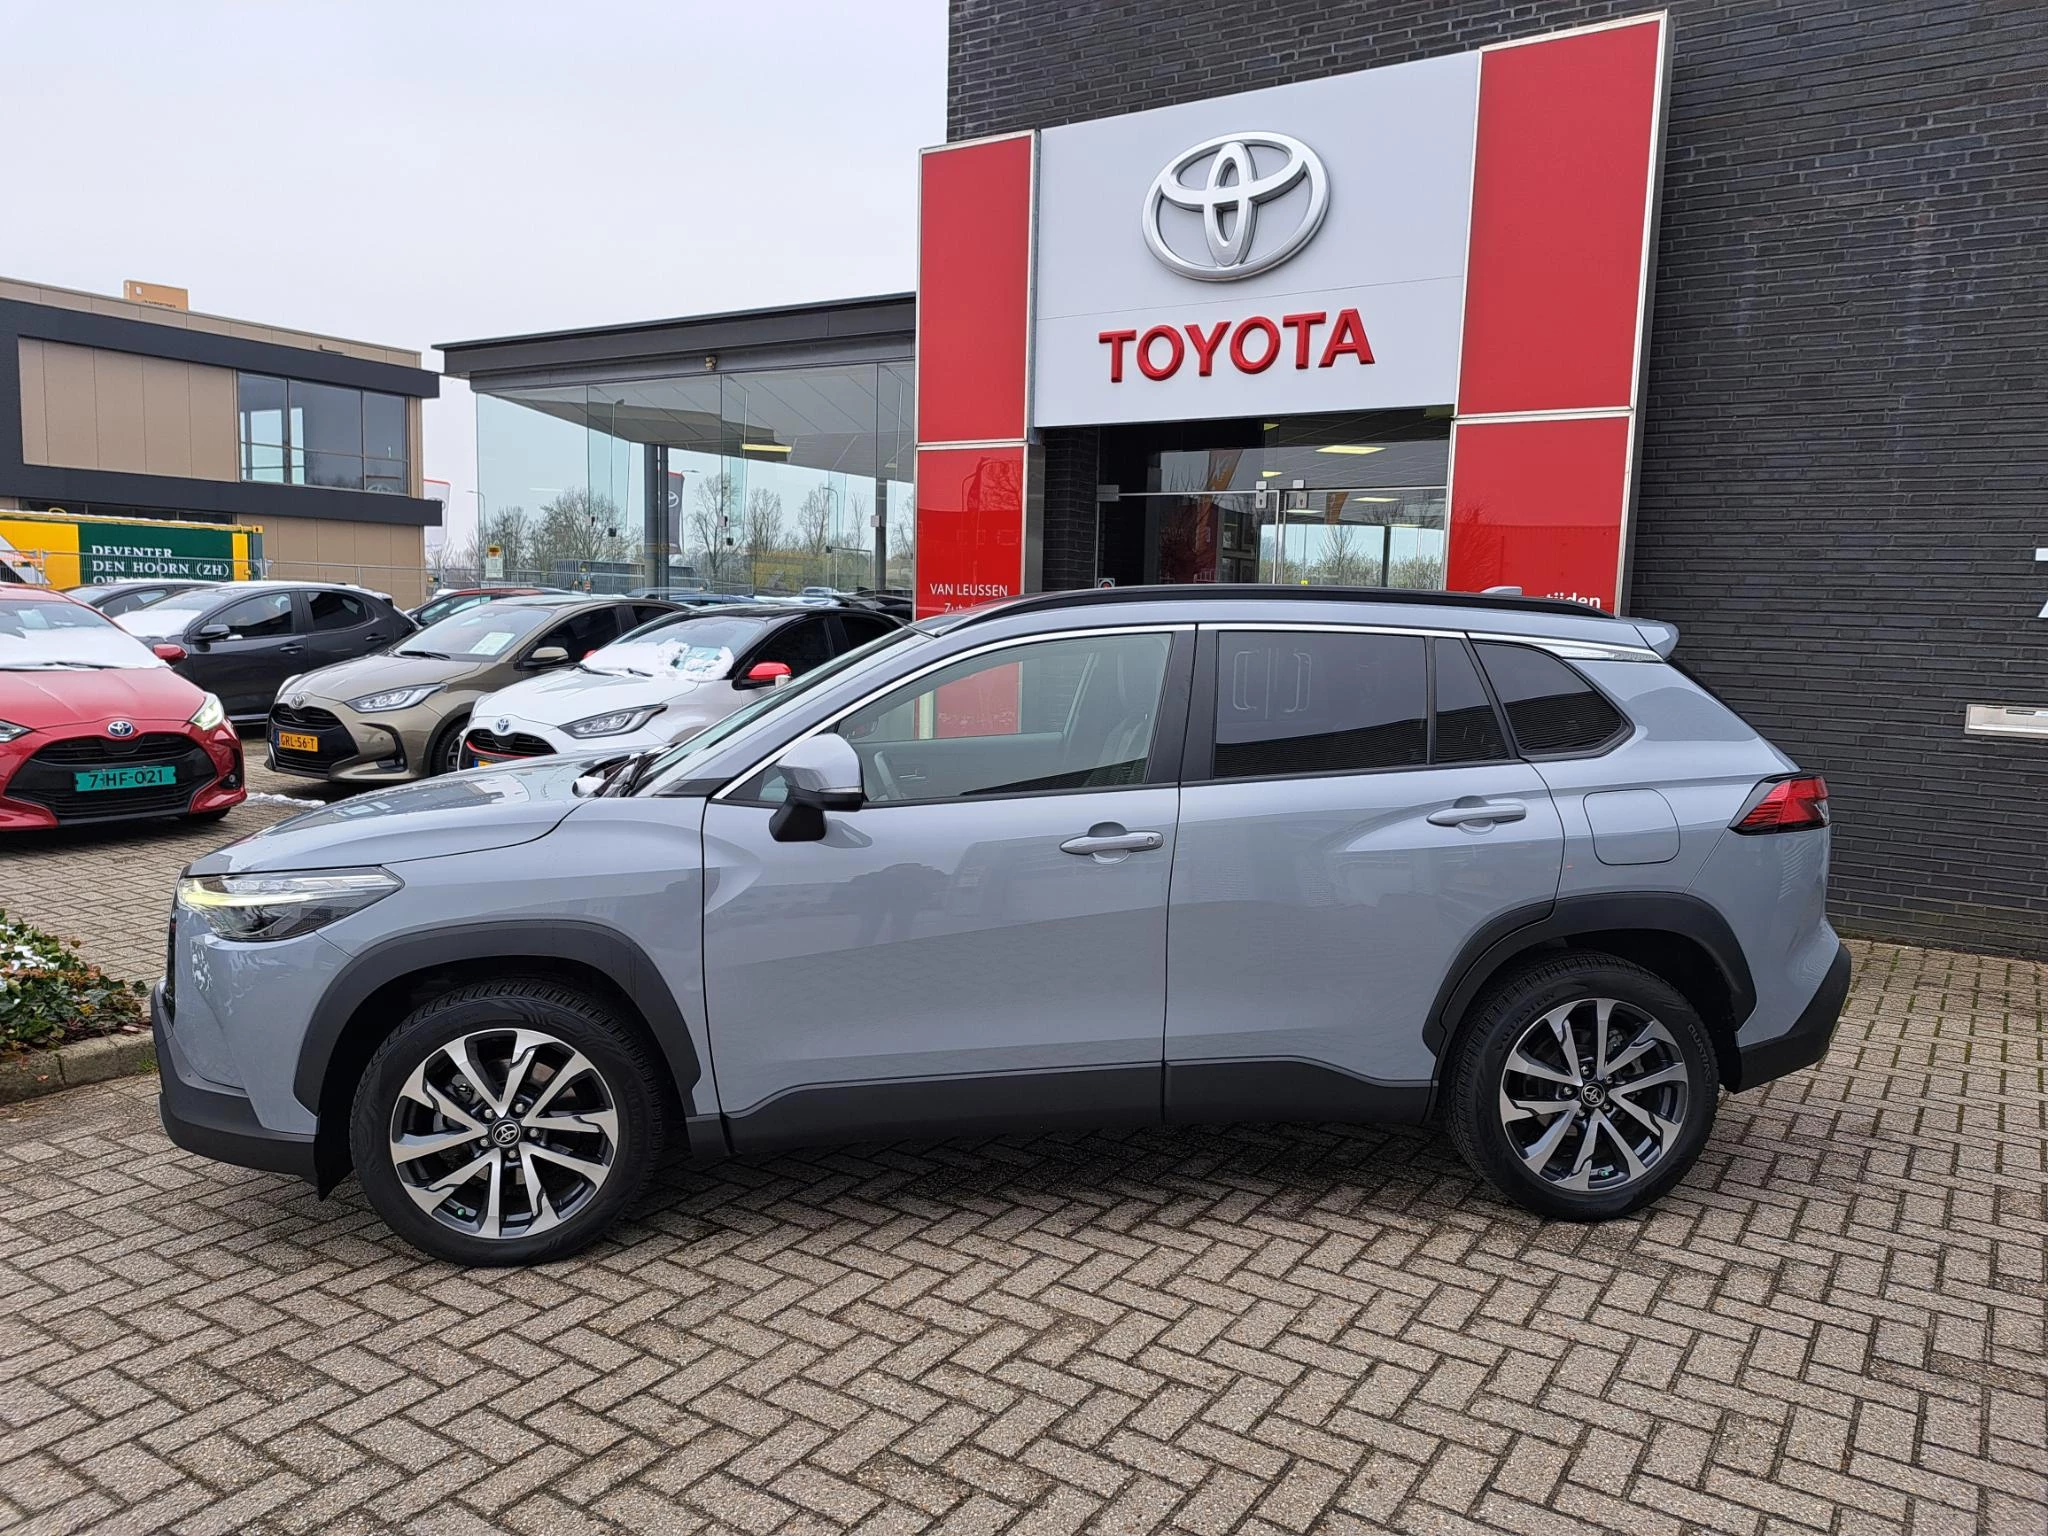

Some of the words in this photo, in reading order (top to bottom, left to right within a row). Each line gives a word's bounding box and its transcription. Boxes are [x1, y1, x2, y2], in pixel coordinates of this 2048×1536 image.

[1099, 308, 1376, 383] TOYOTA
[92, 545, 173, 558] DEVENTER
[92, 560, 125, 572] DEN
[133, 562, 190, 574] HOORN
[196, 562, 230, 577] (ZH)
[929, 583, 954, 595] VAN
[956, 584, 1008, 597] LEUSSEN
[88, 769, 164, 789] 7-HF-021
